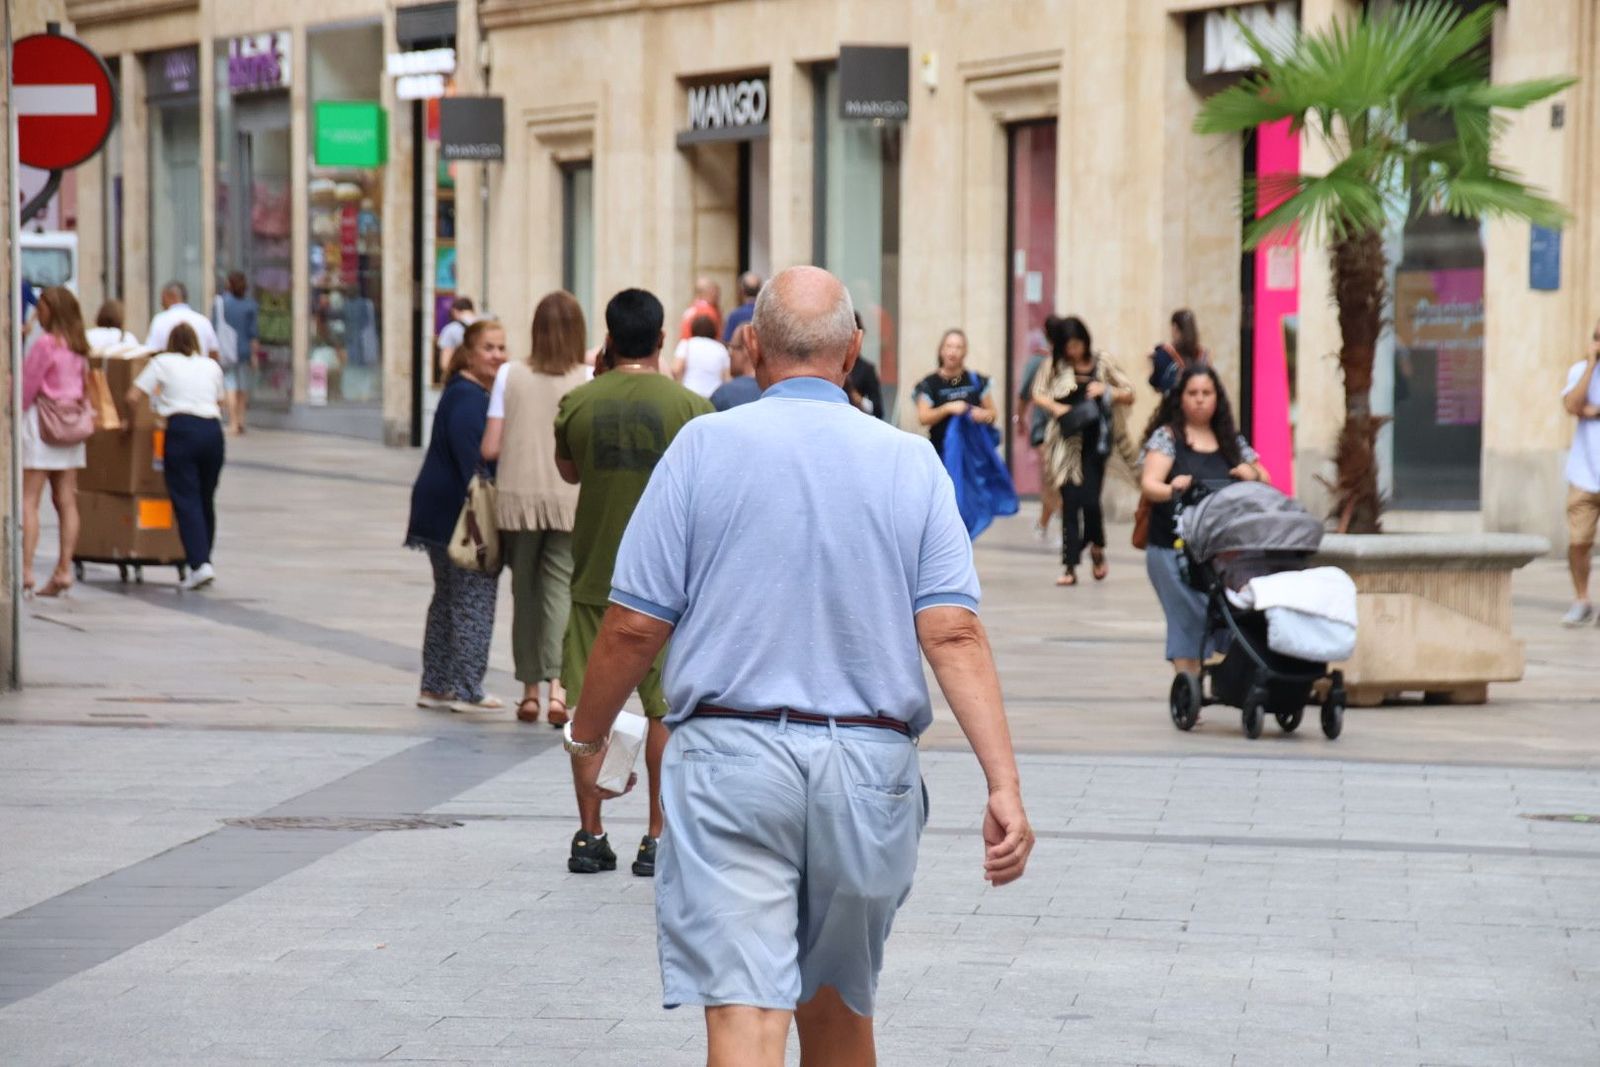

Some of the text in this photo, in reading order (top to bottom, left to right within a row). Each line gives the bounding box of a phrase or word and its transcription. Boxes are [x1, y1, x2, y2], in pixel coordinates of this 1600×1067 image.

[687, 79, 767, 129] MANGO
[845, 100, 907, 116] MANGO
[445, 143, 502, 157] MANGO
